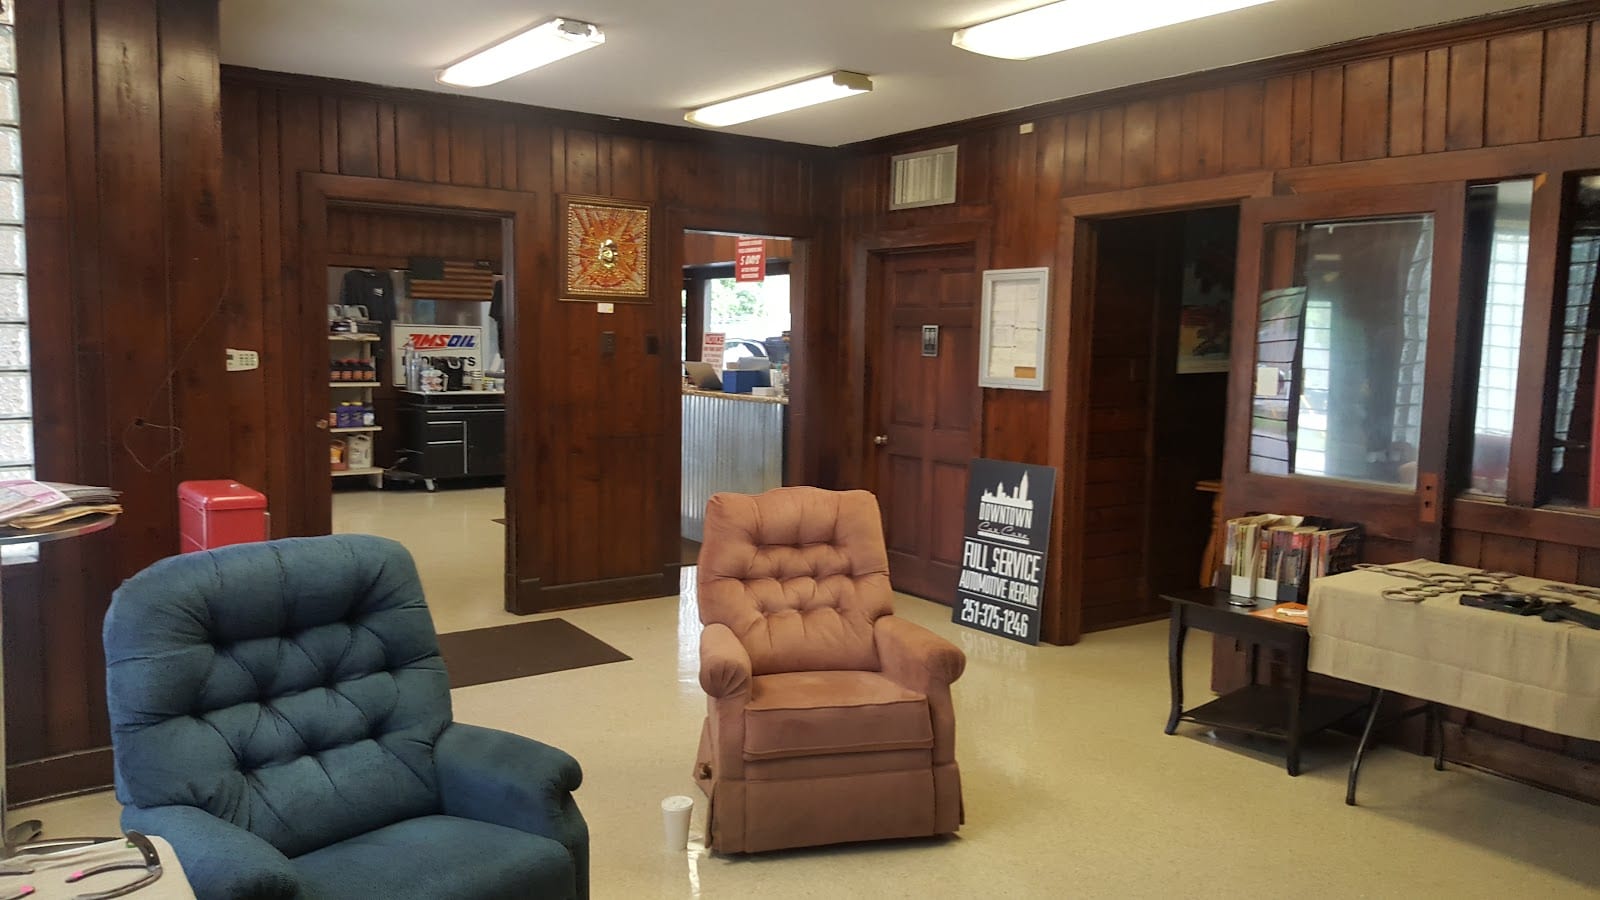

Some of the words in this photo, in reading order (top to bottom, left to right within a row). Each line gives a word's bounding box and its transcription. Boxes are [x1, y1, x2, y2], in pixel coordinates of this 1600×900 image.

[402, 333, 476, 350] AMSOIL
[977, 521, 999, 534] Car
[978, 502, 1033, 529] DOWNTOWN
[962, 540, 989, 571] FULL
[991, 547, 1042, 583] SERVICE
[958, 569, 1008, 599] AUTOMOTIVE
[1008, 580, 1040, 607] REPAIR
[961, 598, 1029, 638] 251-375-1246
